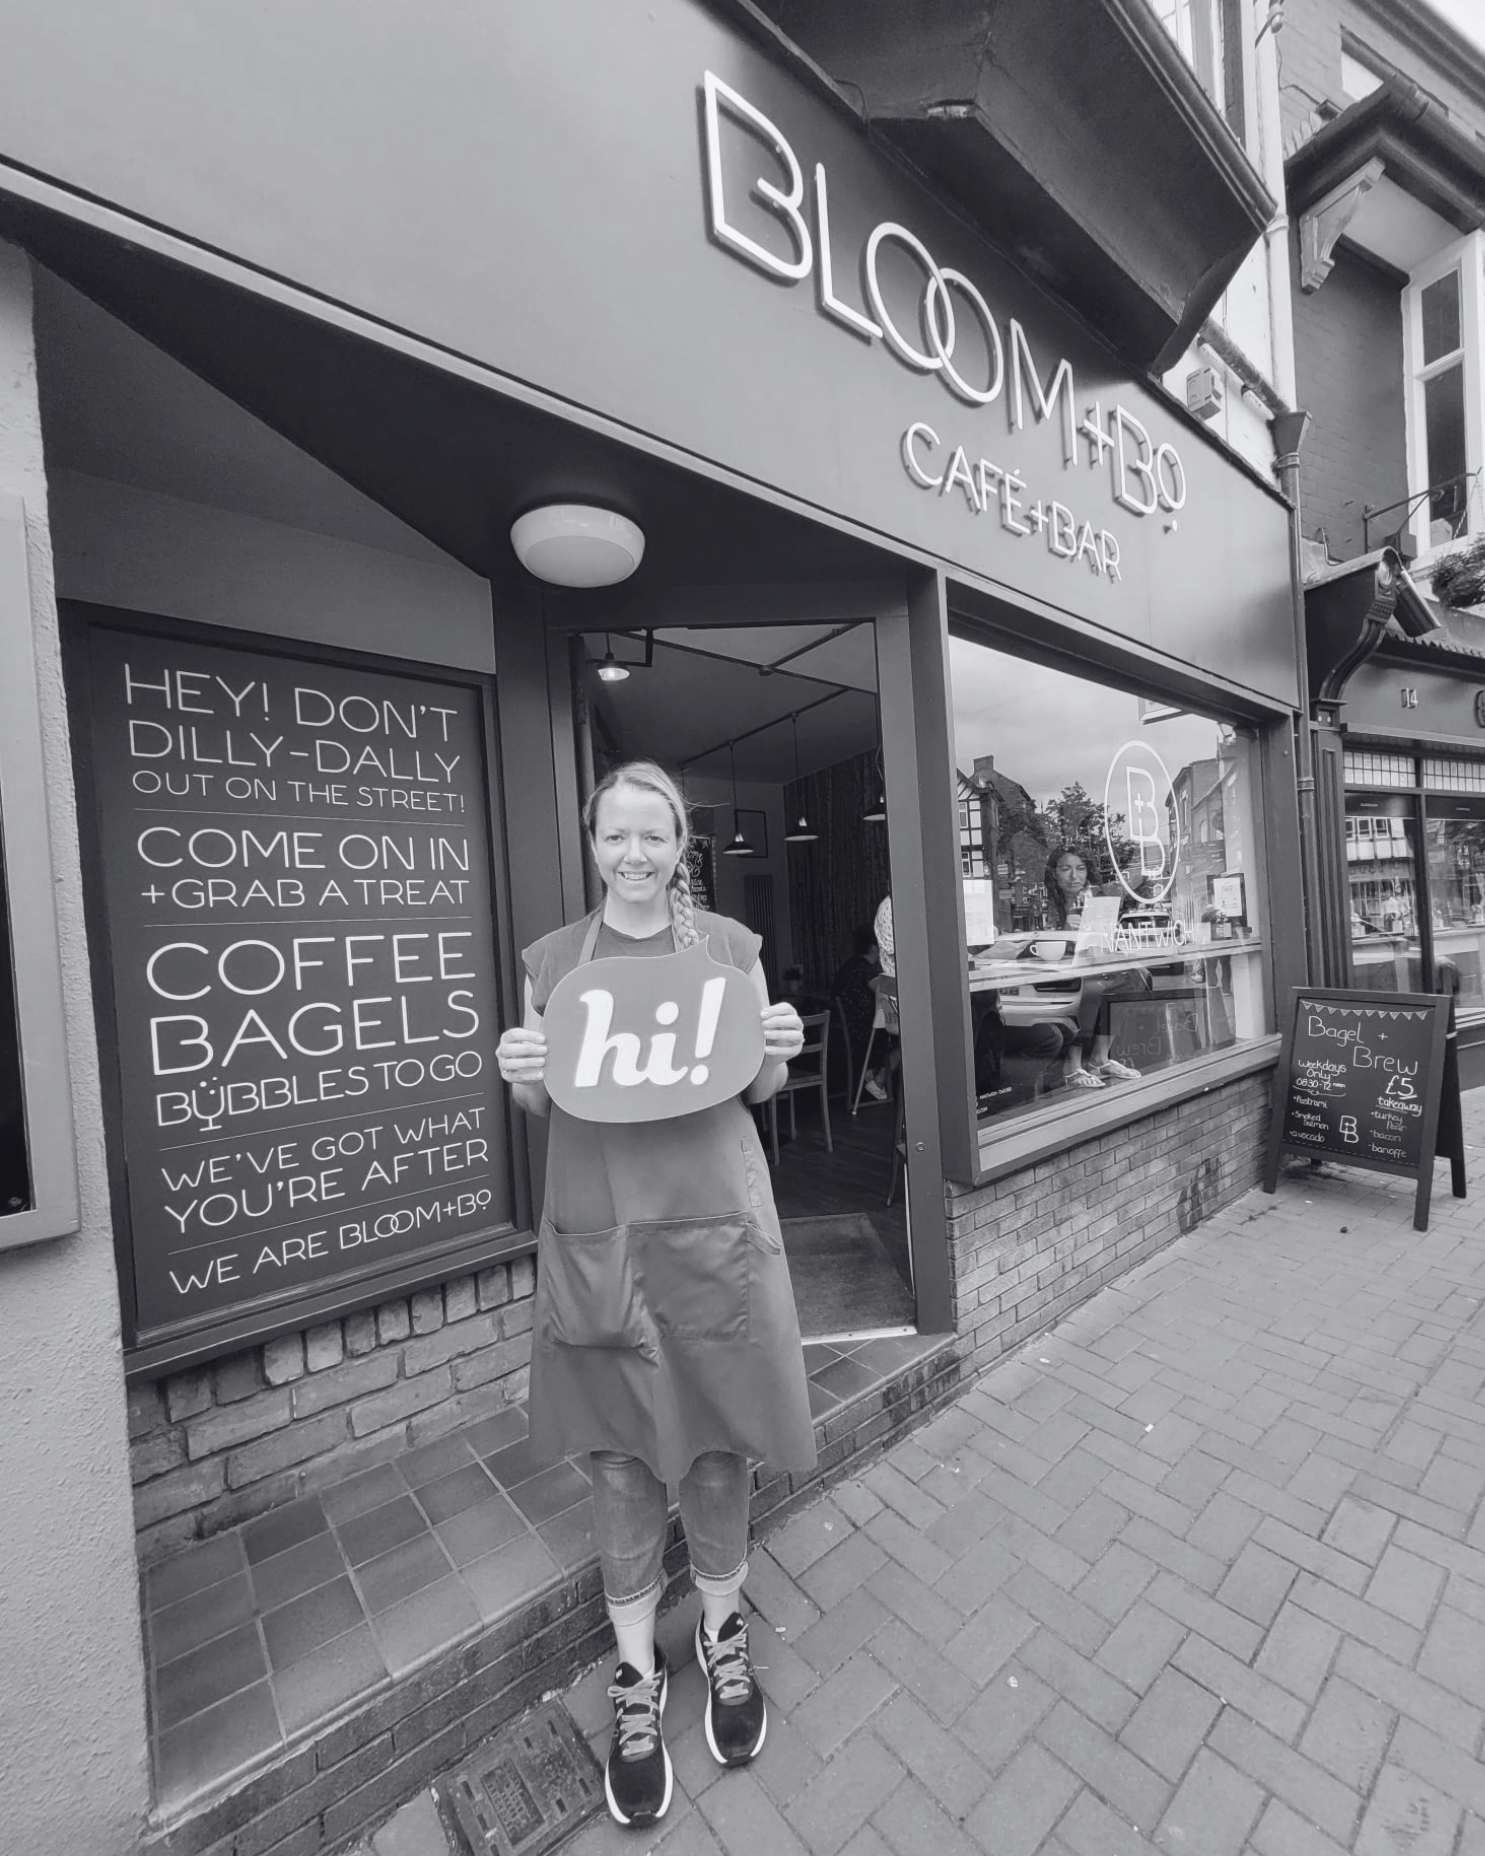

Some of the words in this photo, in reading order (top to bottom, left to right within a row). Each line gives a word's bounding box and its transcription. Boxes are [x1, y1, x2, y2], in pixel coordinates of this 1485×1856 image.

[125, 663, 269, 721] HEY!
[295, 687, 457, 741] DON'T
[132, 771, 213, 796] OUT
[226, 777, 276, 800] ON
[287, 781, 348, 805] THE
[357, 787, 465, 813] STREET!
[137, 827, 325, 868] COME
[339, 834, 414, 870] ON
[430, 837, 469, 870] IN
[319, 880, 348, 906] A
[354, 879, 469, 906] TREAT
[1101, 919, 1194, 954] NANTWICH
[146, 932, 475, 1000] COFFEE
[150, 991, 479, 1076] BAGELS
[574, 977, 726, 1087] hi!
[1309, 1015, 1365, 1047] Bagel
[374, 1059, 424, 1090] TO
[430, 1051, 482, 1081] GO
[1353, 1046, 1418, 1075] Brew
[1377, 1096, 1422, 1117] takeaway
[1385, 1075, 1415, 1097] £5
[161, 1143, 299, 1191] WE'VE
[312, 1127, 383, 1161] GOT
[394, 1107, 485, 1144] WHAT
[165, 1168, 346, 1233] YOU'RE
[361, 1138, 488, 1192] AFTER
[169, 1254, 240, 1293] WE
[253, 1231, 329, 1274] ARE
